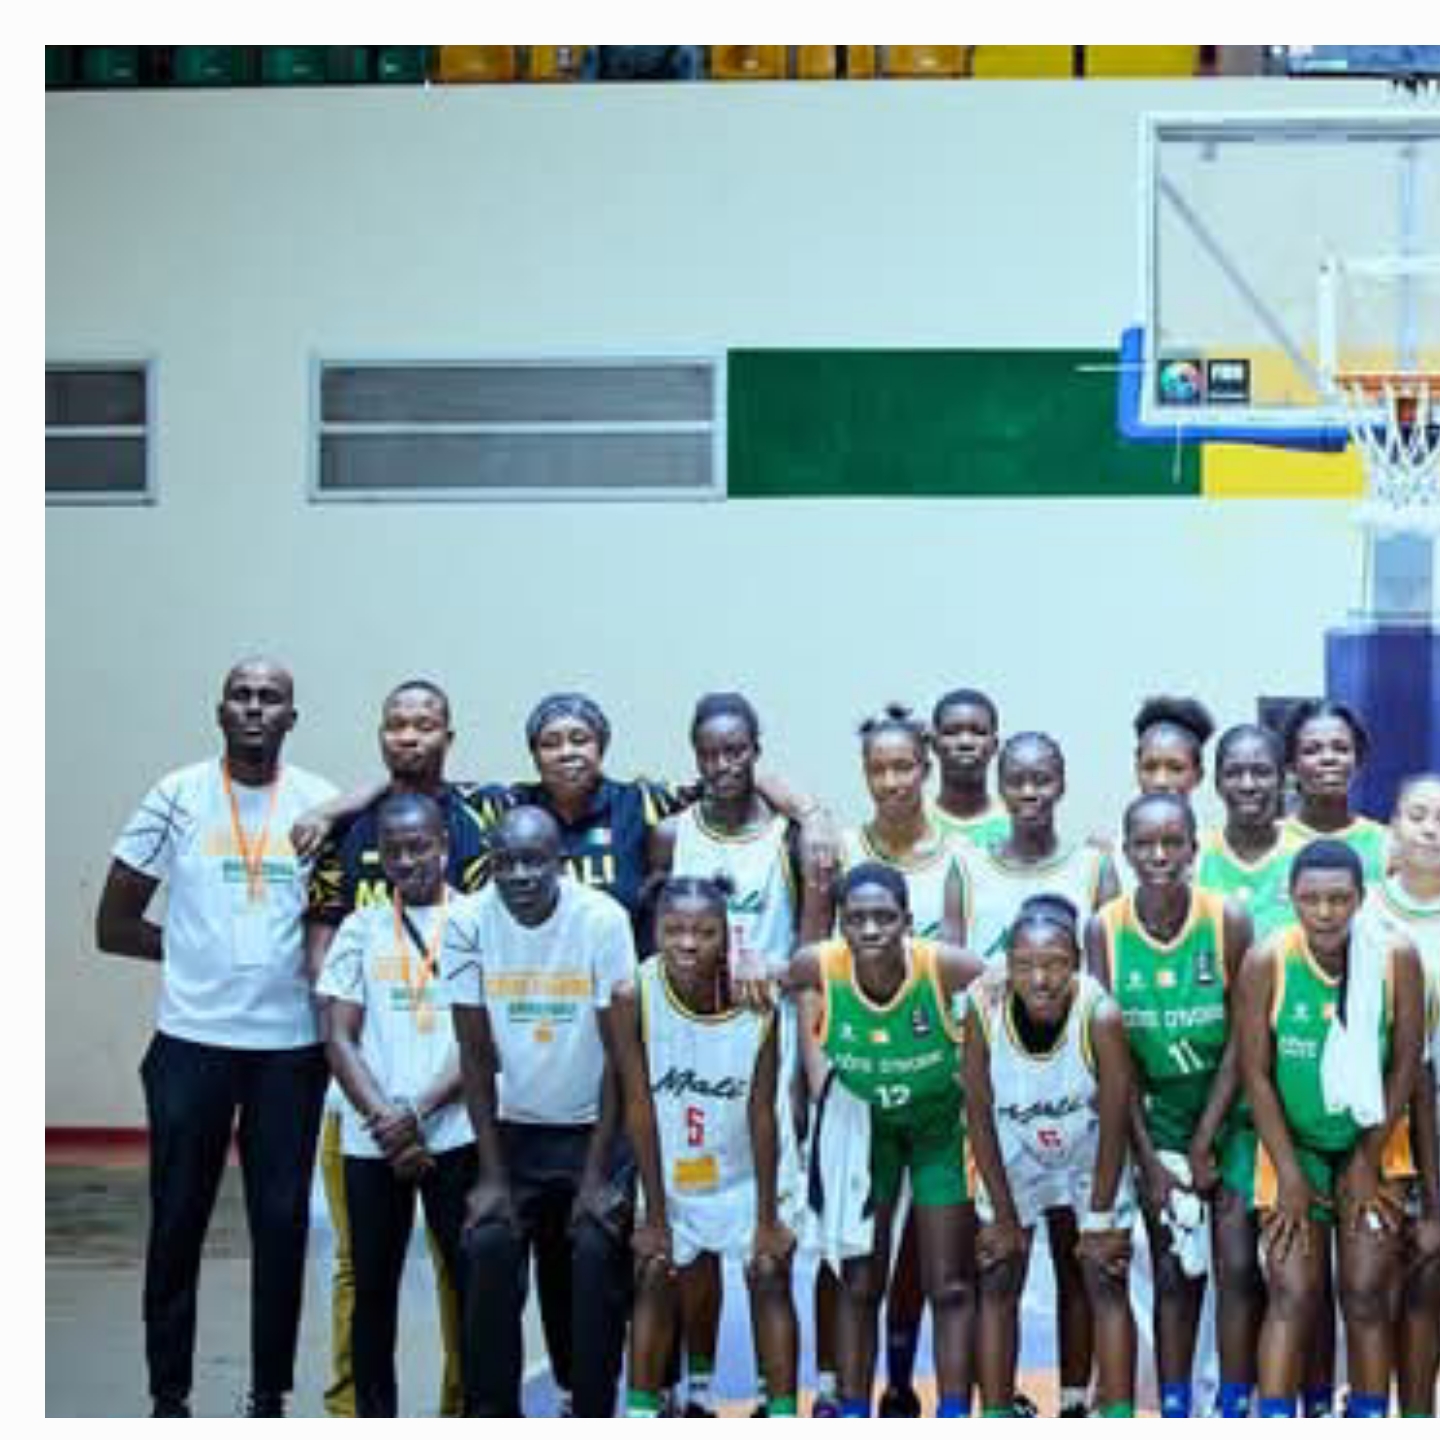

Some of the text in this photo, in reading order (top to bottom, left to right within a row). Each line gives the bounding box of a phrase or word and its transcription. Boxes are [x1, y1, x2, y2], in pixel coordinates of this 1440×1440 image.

[1169, 1037, 1206, 1074] 11
[649, 1065, 748, 1100] Mali
[874, 1083, 913, 1109] 12
[686, 1104, 705, 1148] 5
